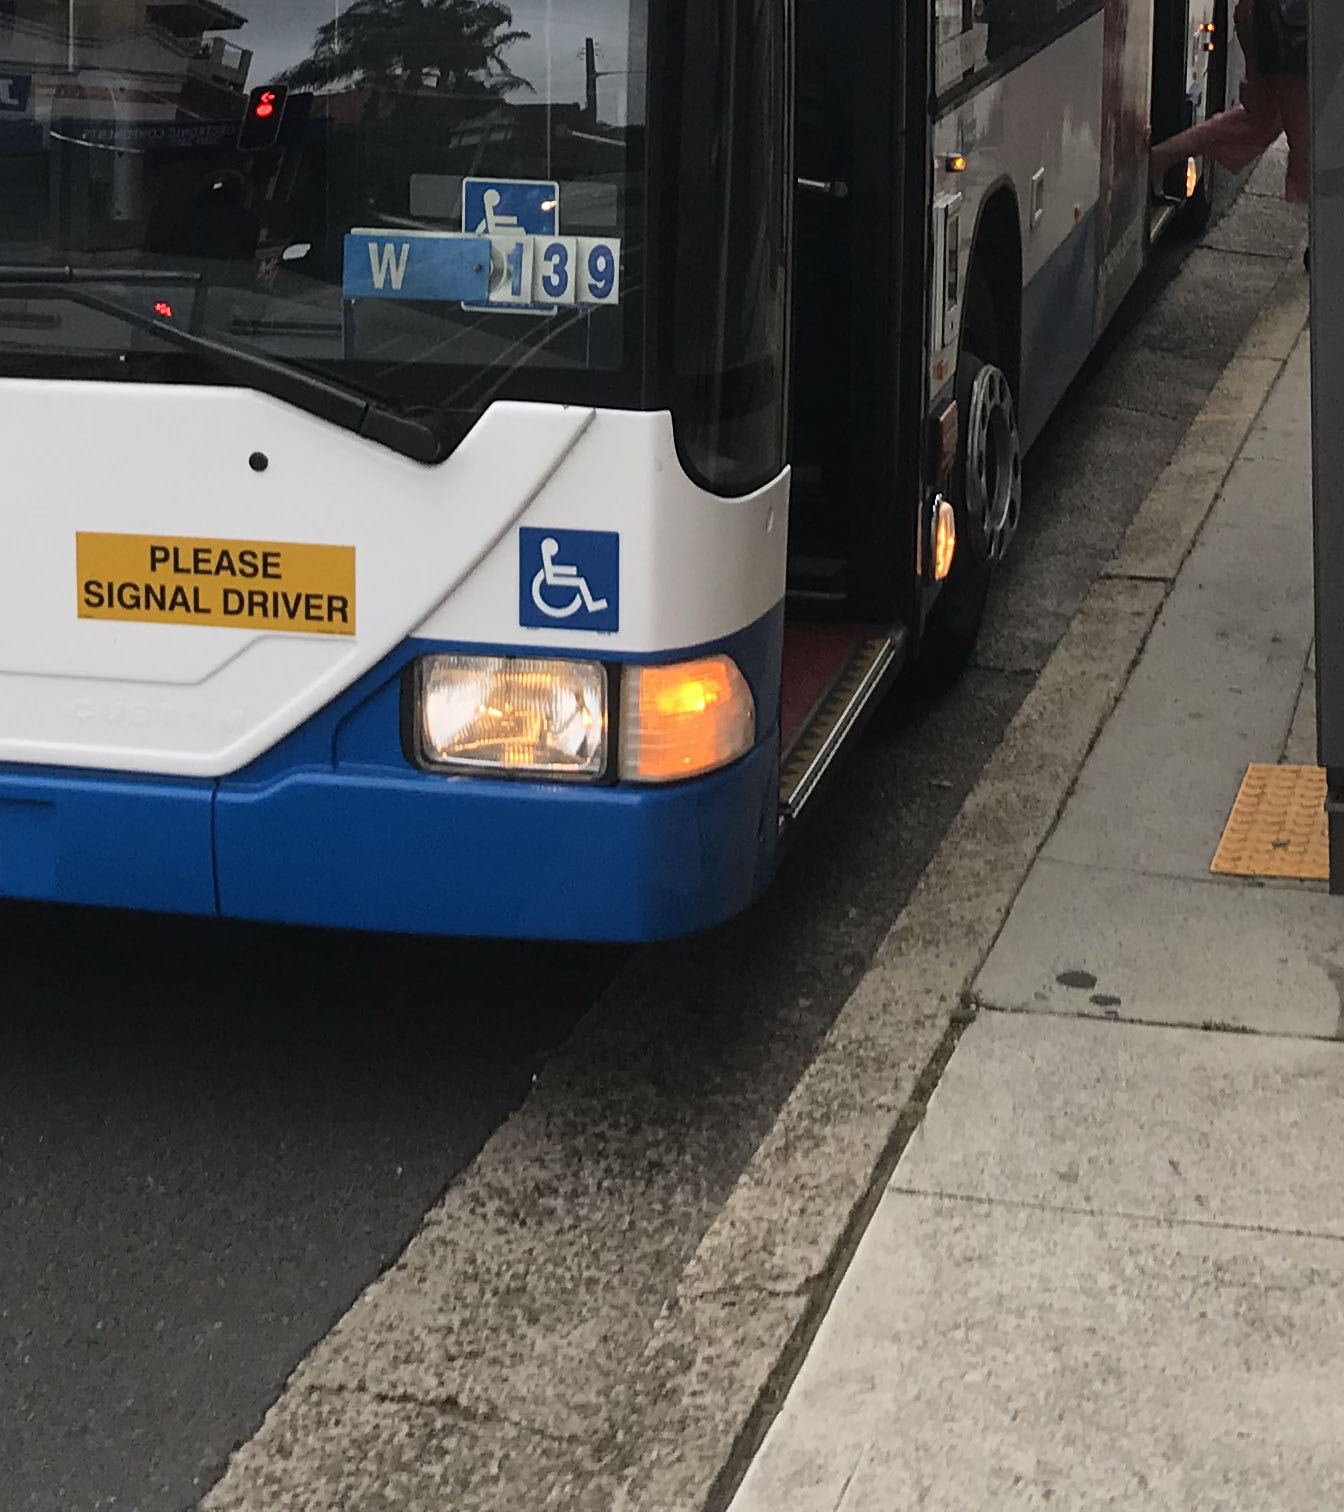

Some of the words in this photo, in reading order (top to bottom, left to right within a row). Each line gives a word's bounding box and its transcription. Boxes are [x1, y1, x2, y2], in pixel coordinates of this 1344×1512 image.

[368, 242, 410, 291] W
[149, 544, 282, 579] PLEASE
[83, 580, 212, 615] SIGNAL
[222, 588, 349, 624] DRIVER
